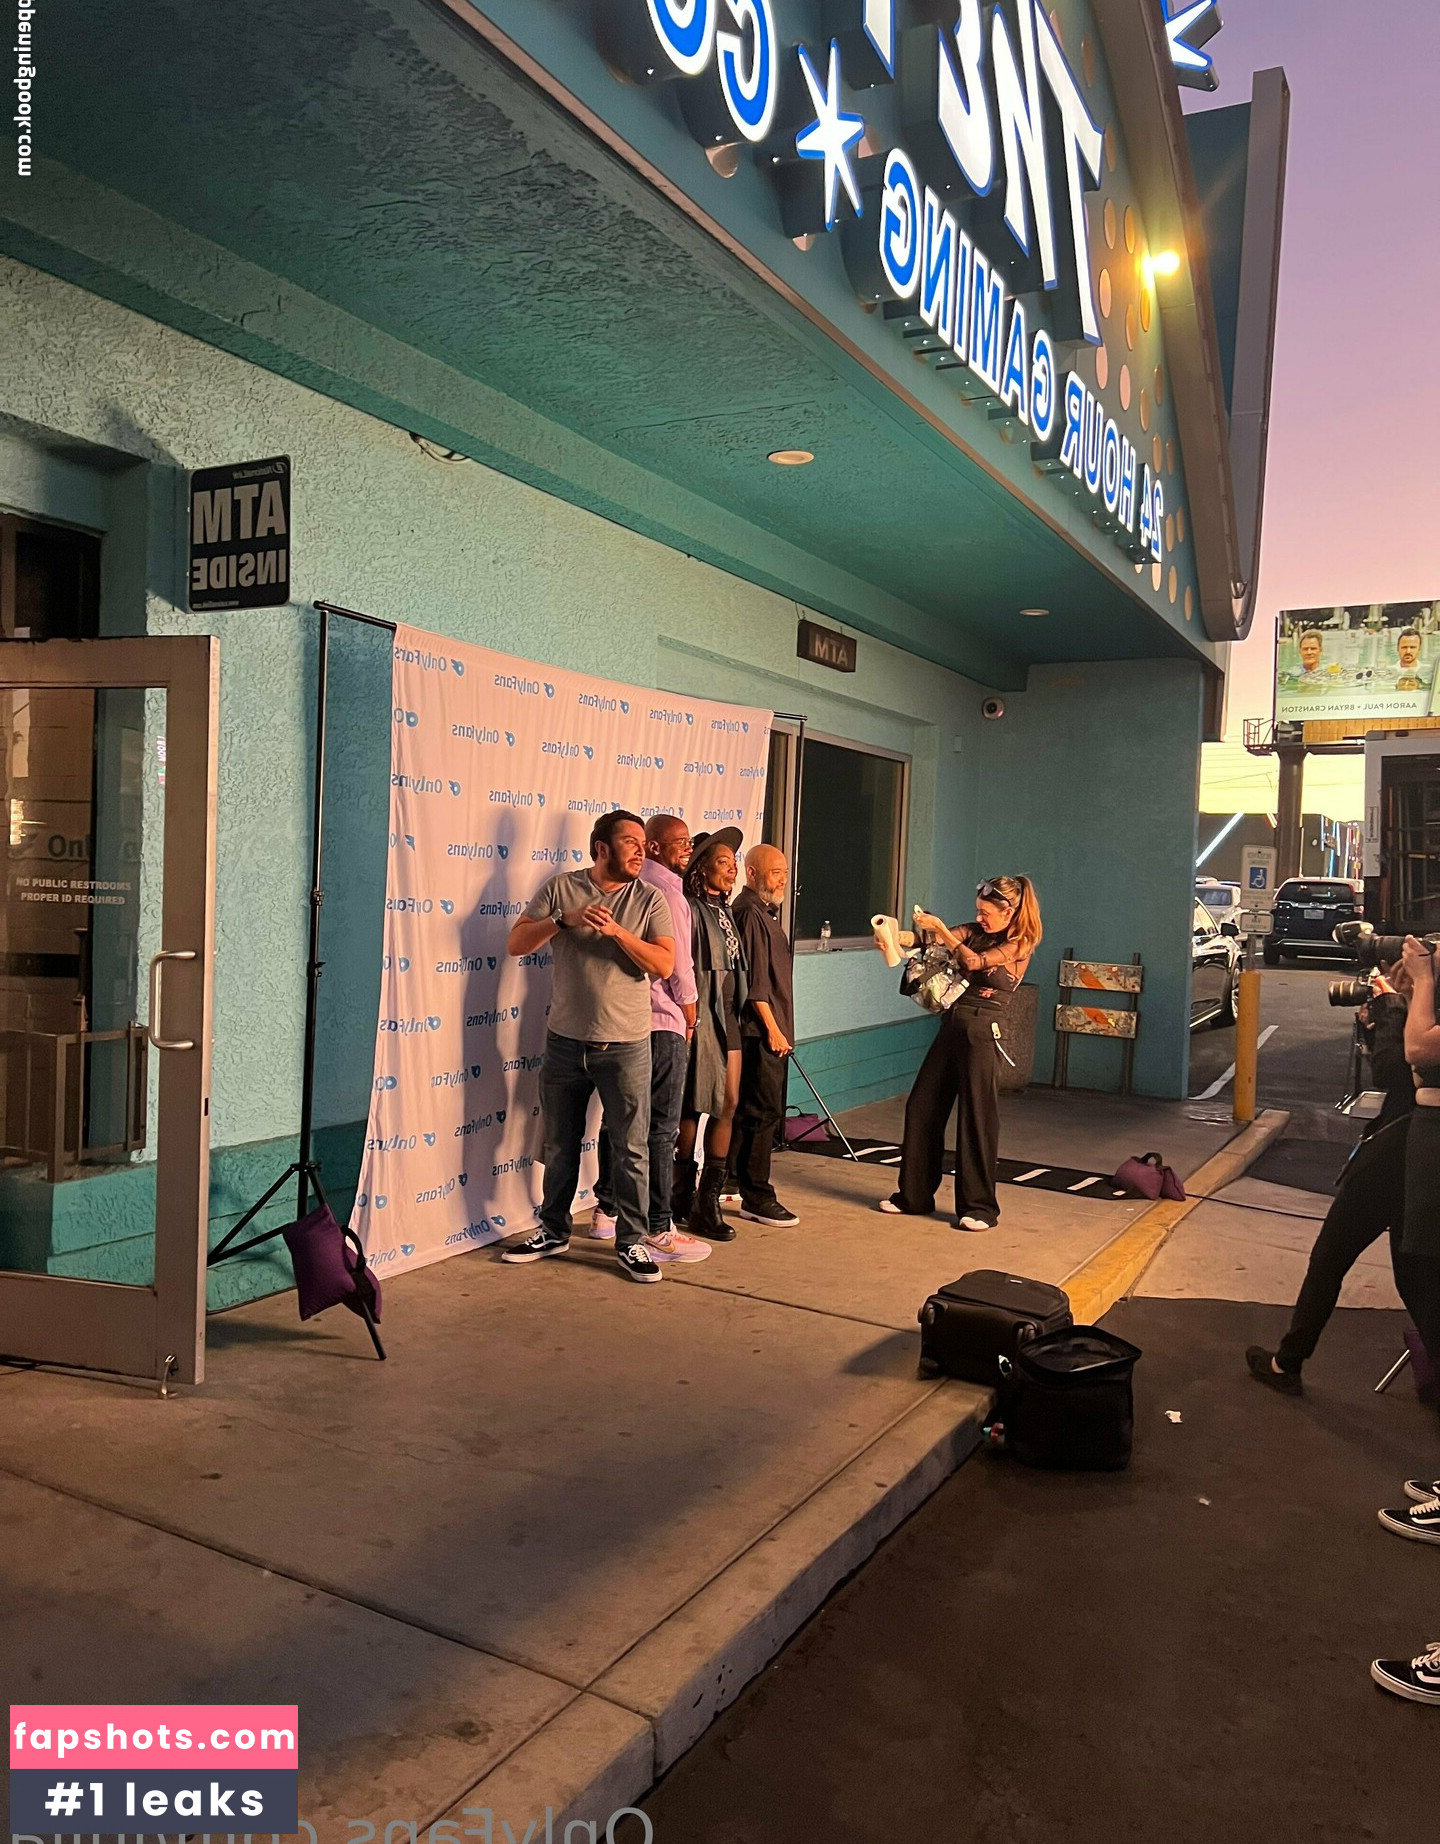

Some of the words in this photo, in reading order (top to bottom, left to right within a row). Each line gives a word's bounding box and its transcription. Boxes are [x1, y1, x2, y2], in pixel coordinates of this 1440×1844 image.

[32, 878, 68, 889] PUBLIC
[70, 880, 132, 891] RESTROOMS
[21, 892, 59, 903] PROPER
[61, 893, 72, 903] ID
[74, 894, 126, 905] REQUIRED
